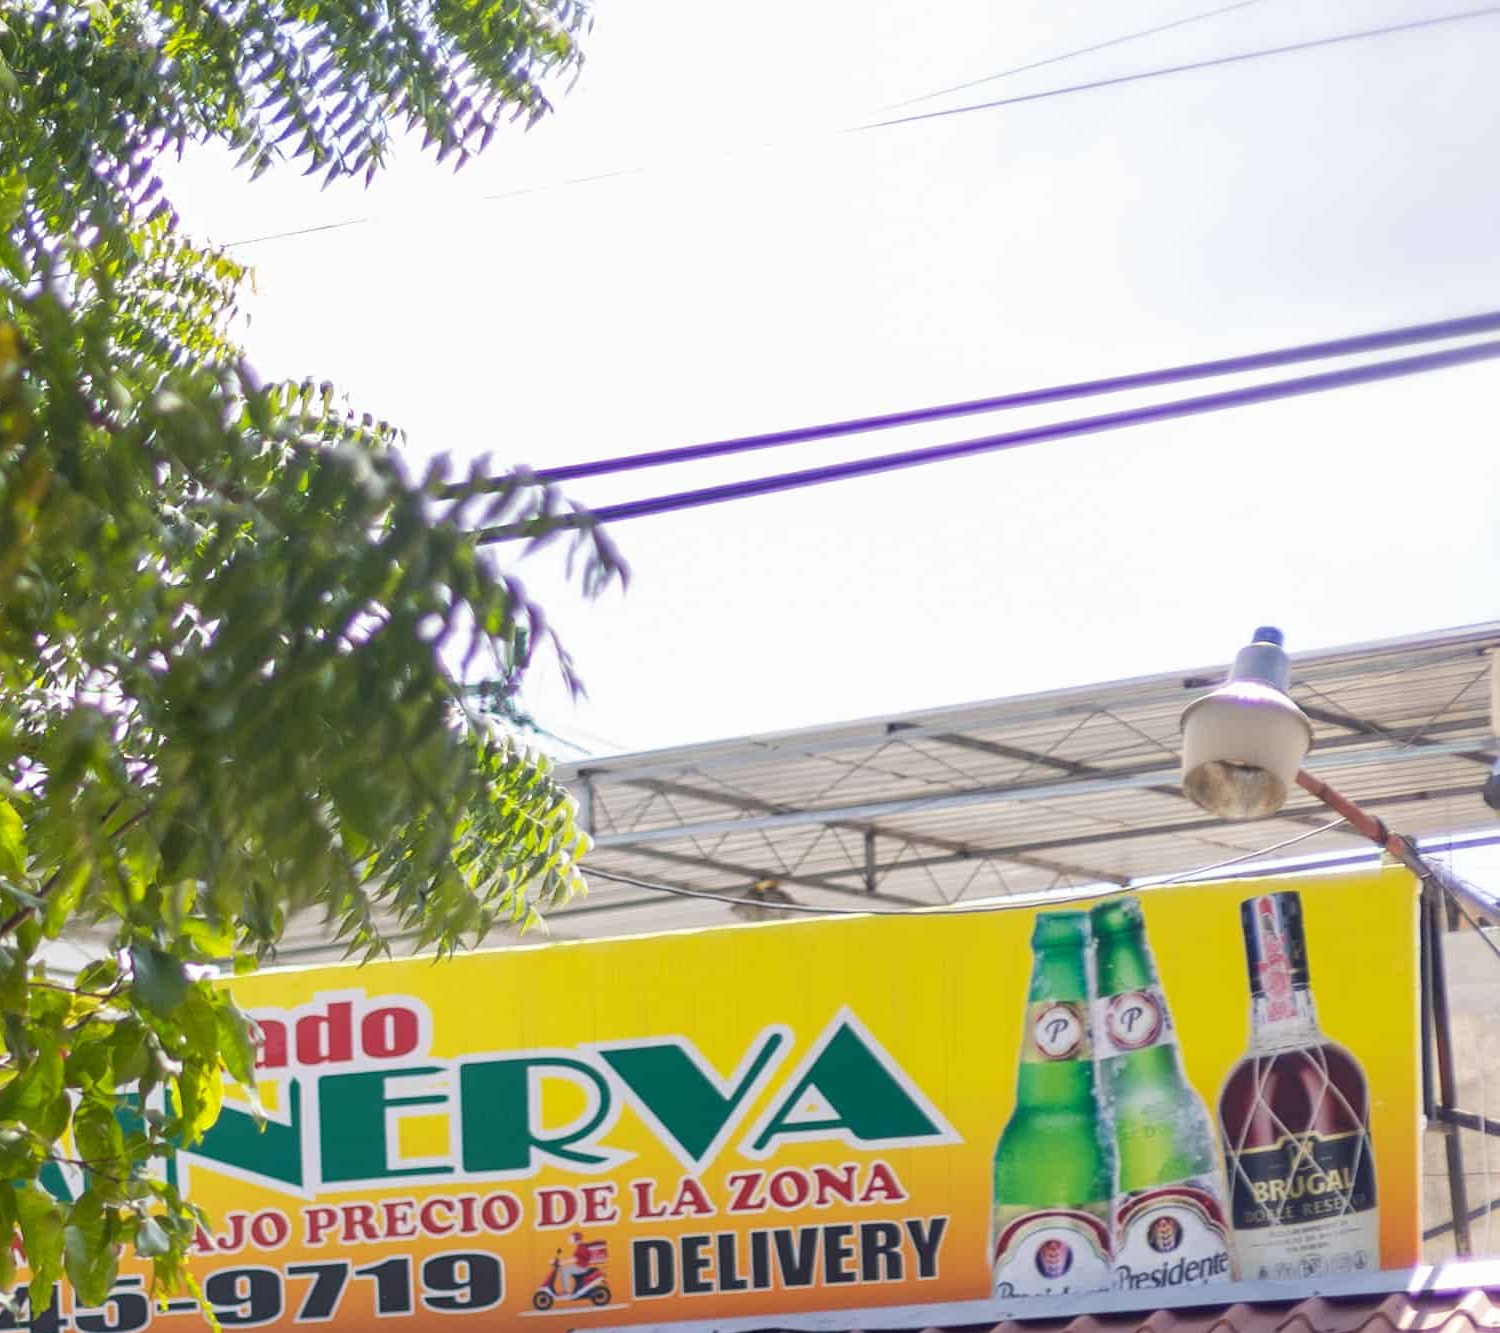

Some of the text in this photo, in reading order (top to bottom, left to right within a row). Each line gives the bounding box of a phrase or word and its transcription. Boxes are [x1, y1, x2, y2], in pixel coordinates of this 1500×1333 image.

[307, 1194, 520, 1243] PRECIO
[538, 1187, 615, 1226] DE
[634, 1179, 713, 1218] LA
[729, 1164, 904, 1212] ZONA
[1253, 1169, 1354, 1203] BRUGAL
[632, 1218, 947, 1298] DELIVERY
